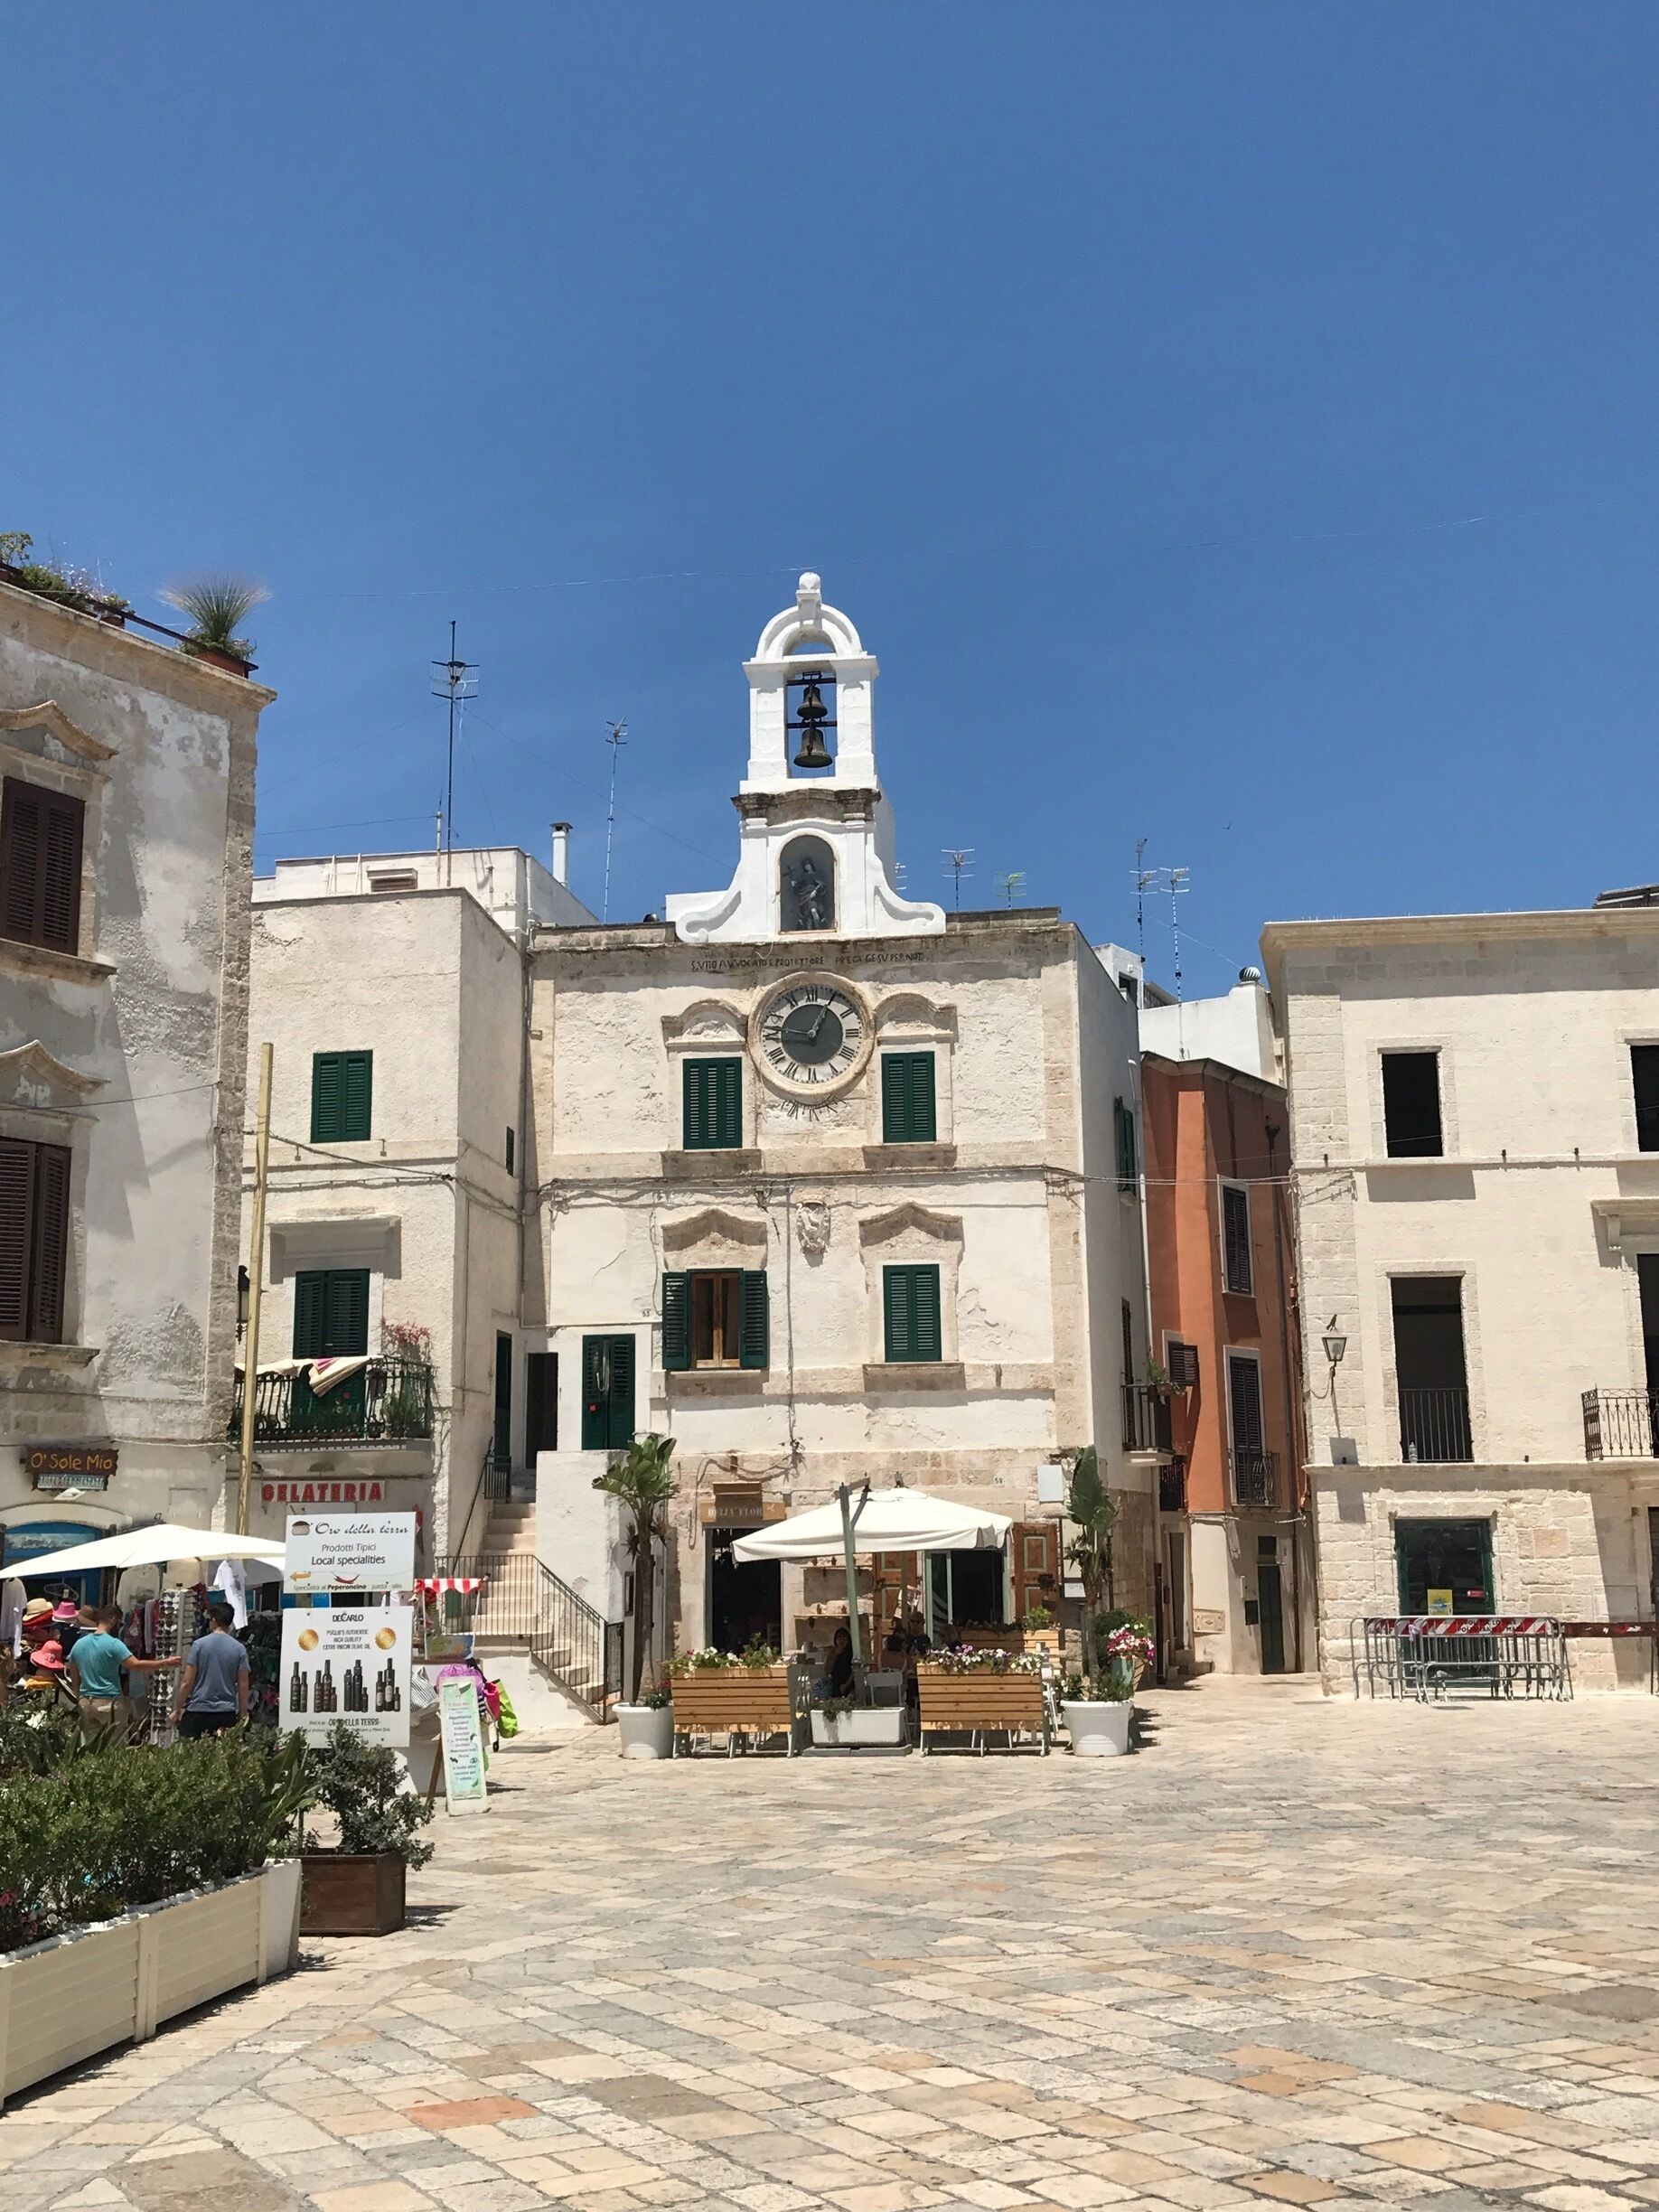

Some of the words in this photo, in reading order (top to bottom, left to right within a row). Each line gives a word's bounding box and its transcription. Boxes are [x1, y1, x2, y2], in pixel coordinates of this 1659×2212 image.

[775, 956, 824, 967] PROTETTORE
[49, 1453, 81, 1470] Sole
[86, 1454, 113, 1471] Mio
[261, 1482, 382, 1502] GELATERIA
[314, 1522, 341, 1535] Oro
[344, 1523, 375, 1534] della
[380, 1523, 408, 1534] terra
[322, 1543, 353, 1552] Prodotti
[356, 1542, 377, 1553] Tipici
[311, 1556, 335, 1566] Local
[337, 1555, 386, 1567] specialities
